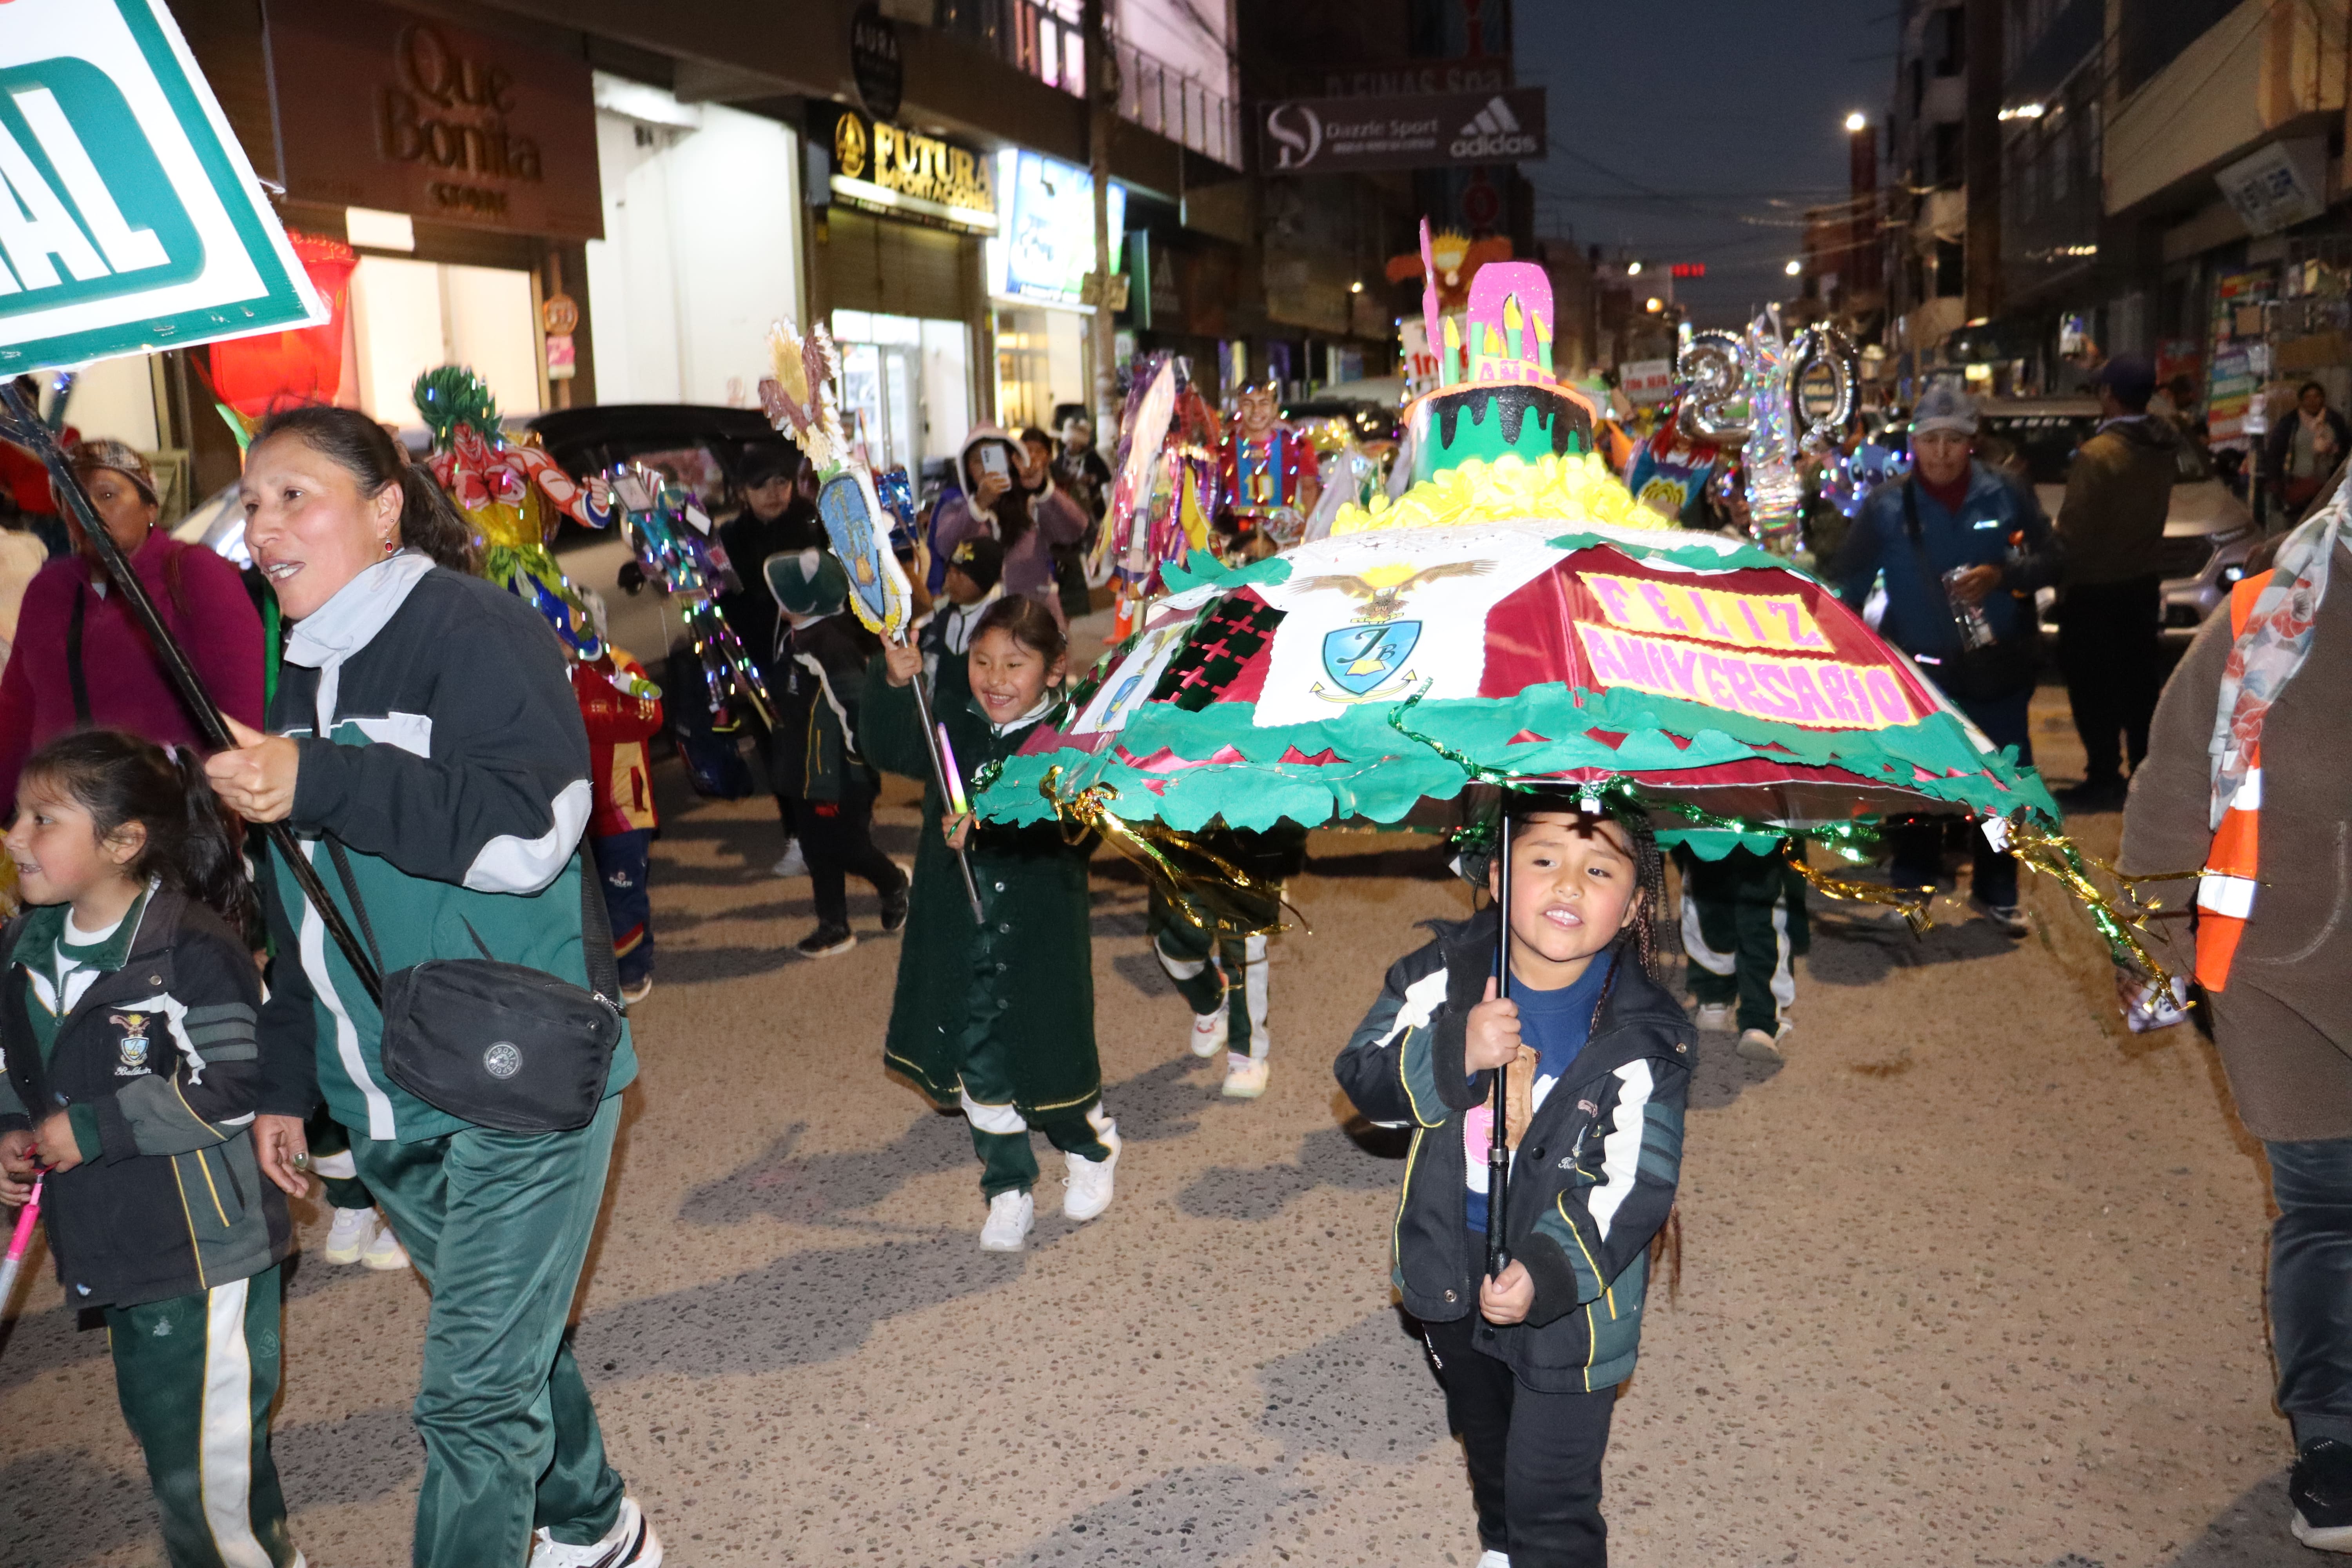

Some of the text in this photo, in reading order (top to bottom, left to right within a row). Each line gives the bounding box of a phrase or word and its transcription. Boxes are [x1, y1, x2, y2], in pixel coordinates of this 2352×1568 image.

[1389, 118, 1439, 138] Sport
[1449, 134, 1537, 158] adidas
[873, 121, 993, 193] FUTURA
[0, 88, 170, 296] AL
[1244, 475, 1274, 500] 10
[1590, 577, 1824, 646] FELIZ
[1583, 626, 1910, 723] ANIVERSARIO
[114, 1066, 152, 1076] Baldwin
